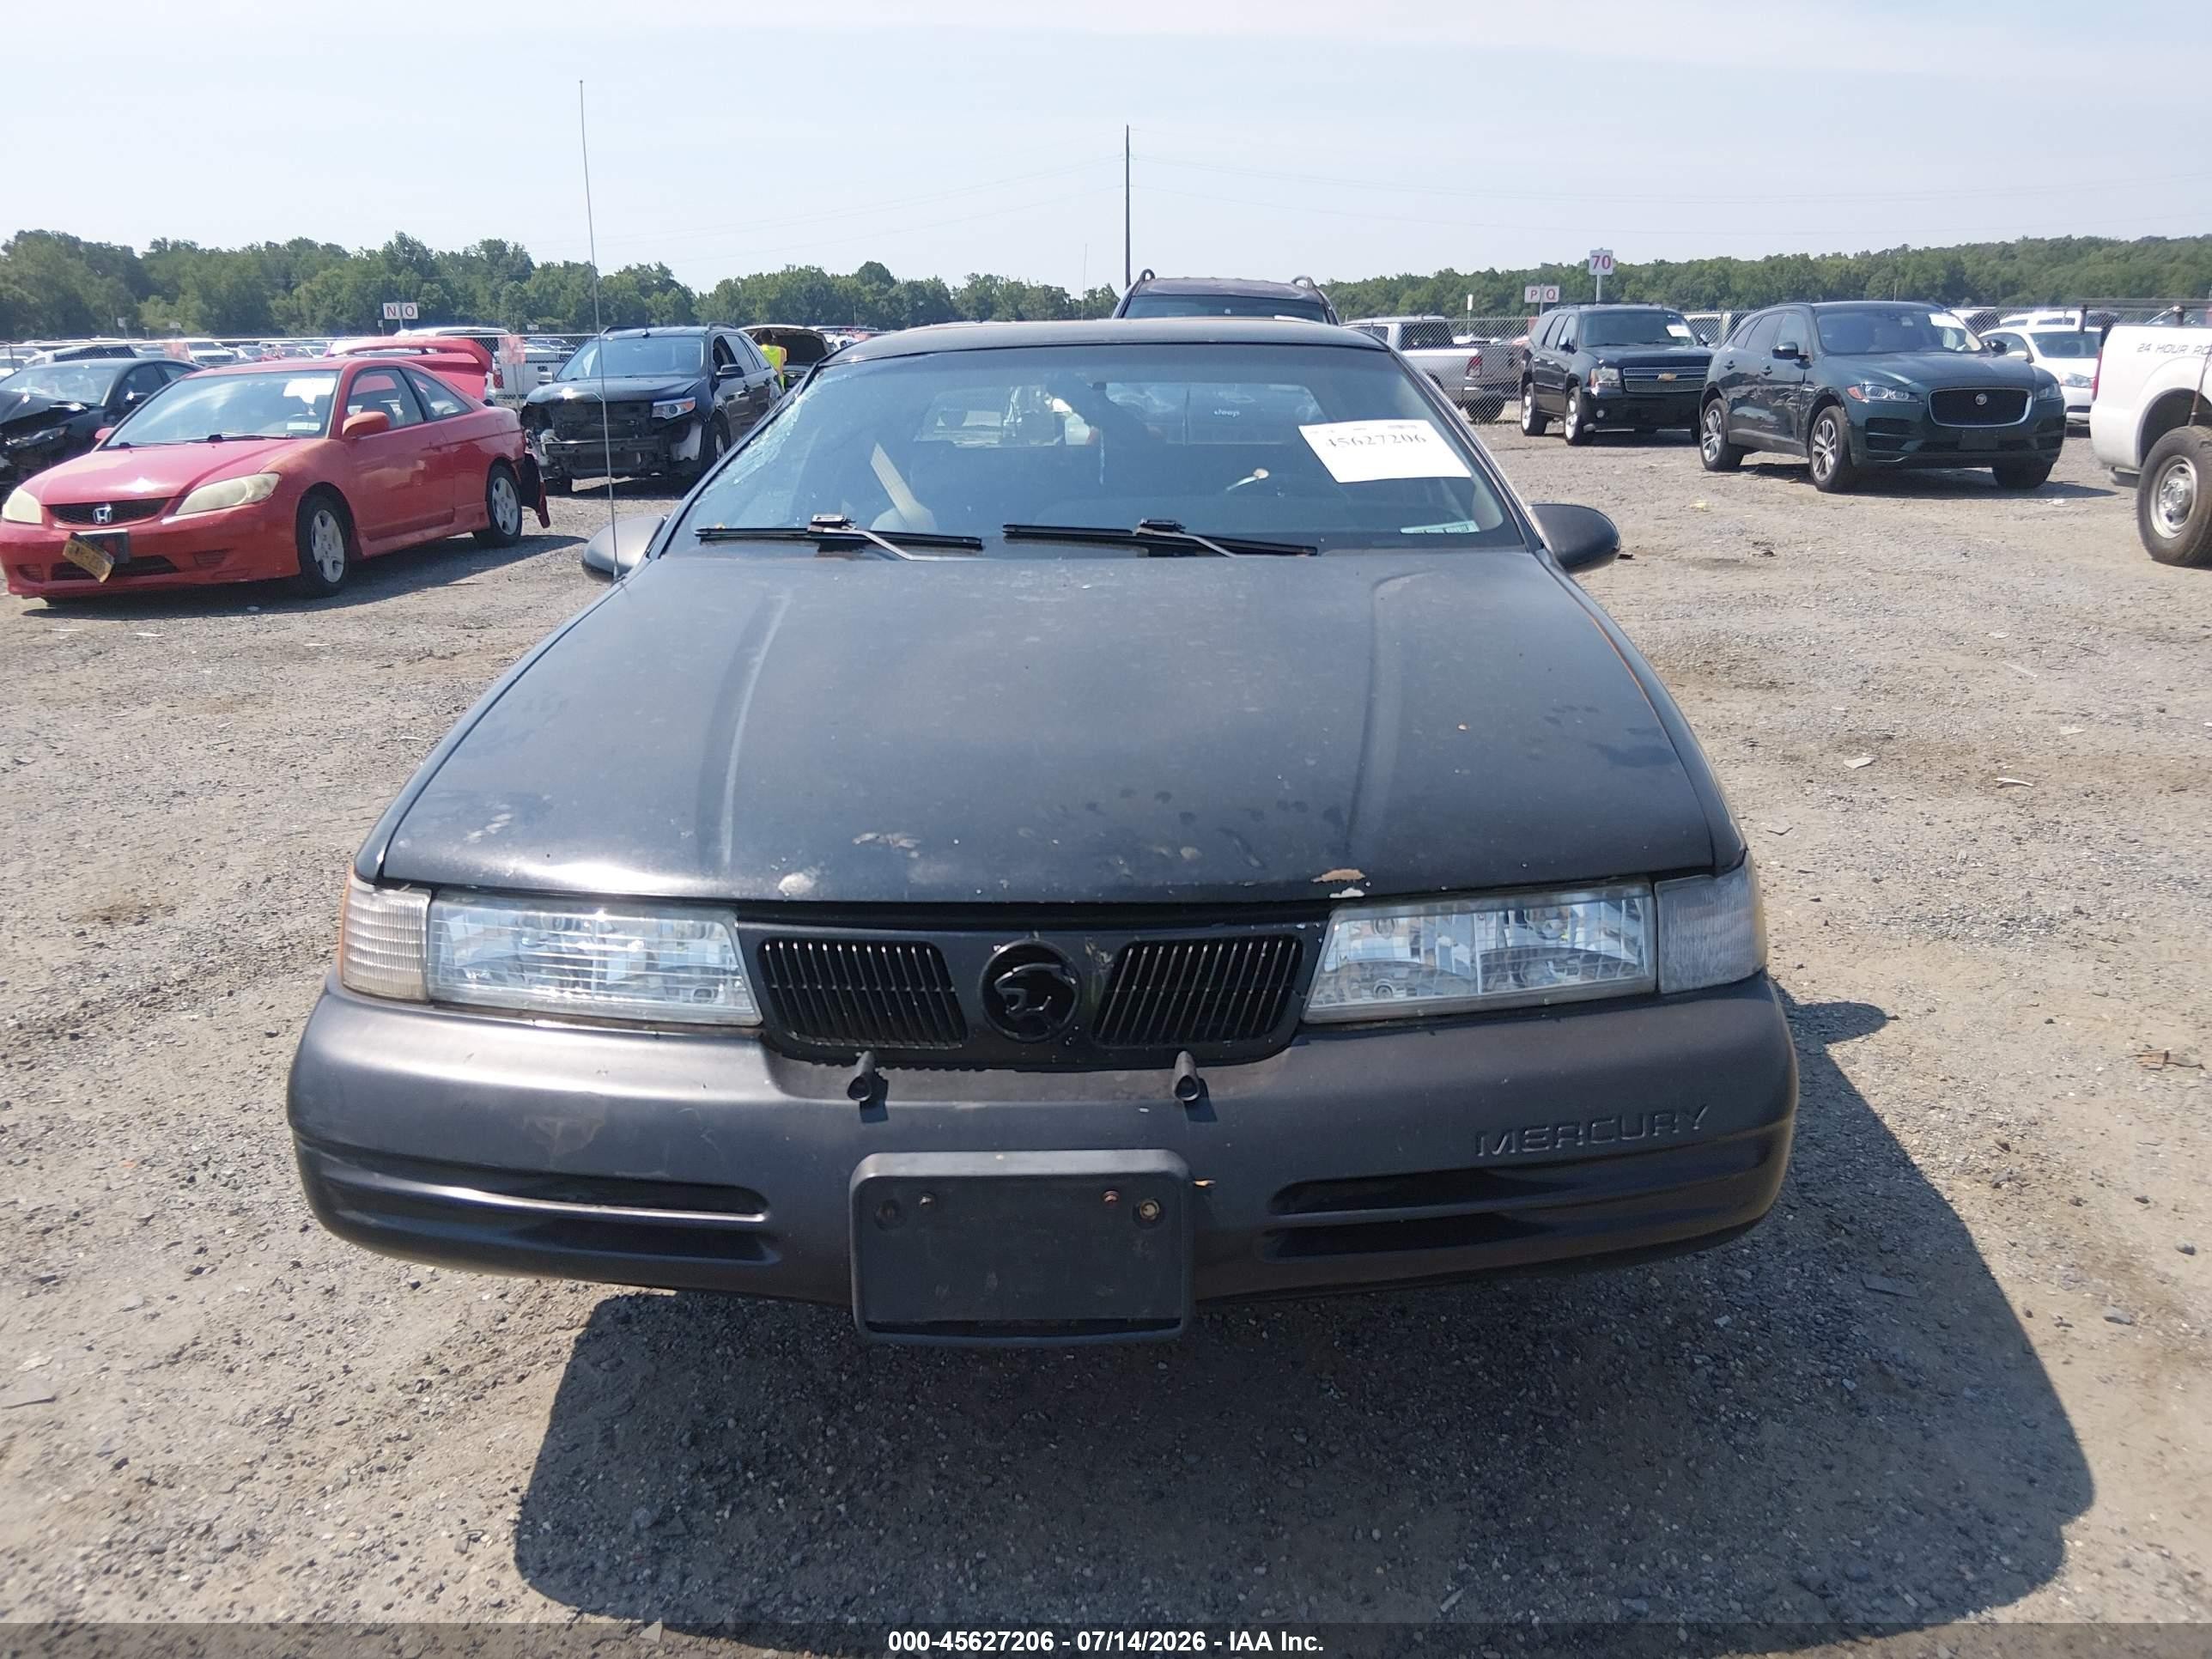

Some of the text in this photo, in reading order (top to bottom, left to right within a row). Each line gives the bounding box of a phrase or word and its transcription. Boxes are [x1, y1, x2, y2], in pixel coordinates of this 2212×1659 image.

[1591, 254, 1611, 270] 70
[1530, 289, 1557, 301] P Q
[386, 306, 415, 317] N O
[2136, 343, 2152, 353] 24
[2154, 343, 2189, 355] HOUR
[1475, 1104, 1709, 1158] MERCURY
